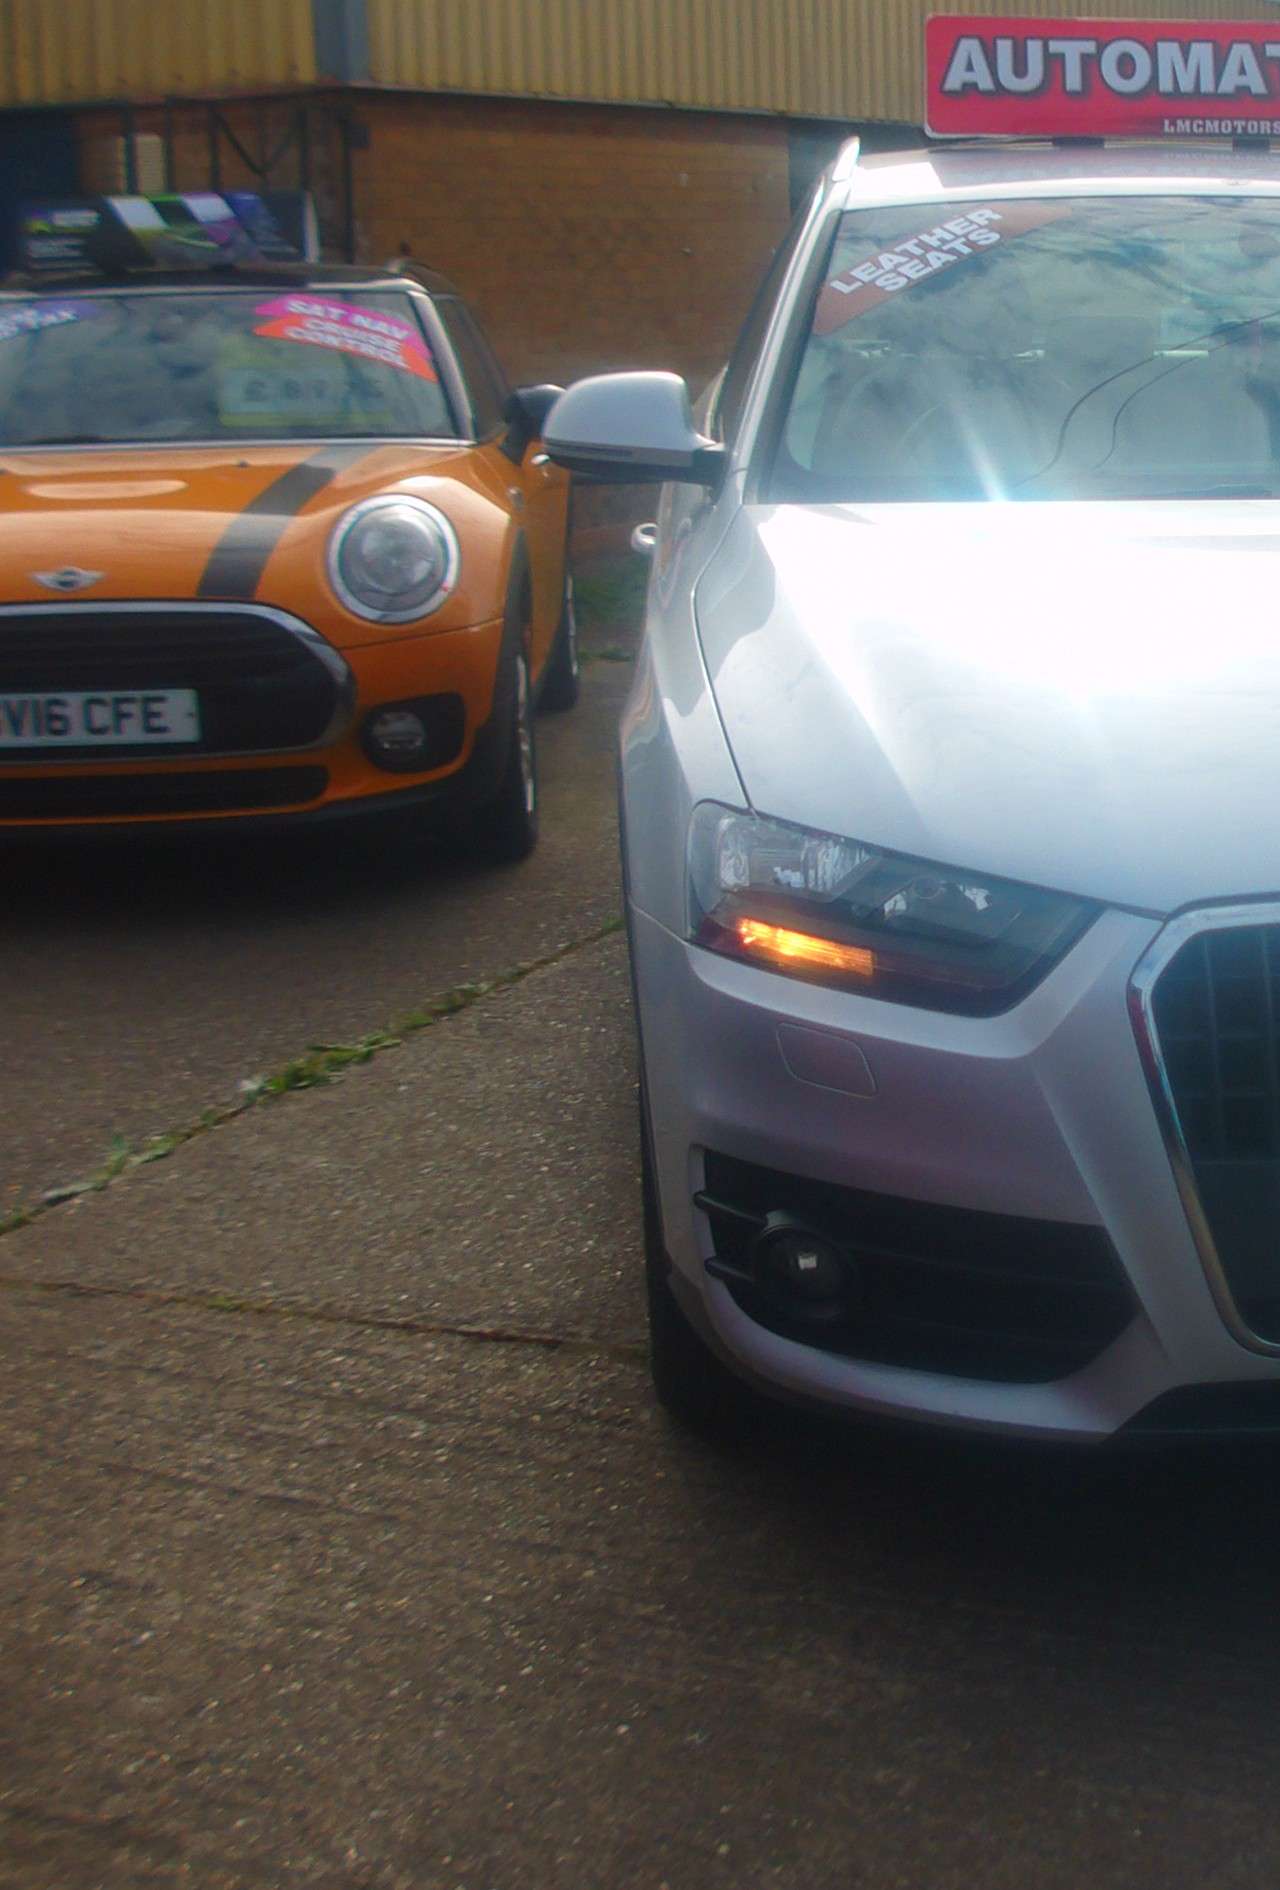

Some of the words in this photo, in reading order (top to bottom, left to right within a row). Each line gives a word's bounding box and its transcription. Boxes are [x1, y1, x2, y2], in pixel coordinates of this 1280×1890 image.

[830, 207, 1003, 296] LEATHER
[874, 228, 1001, 292] SEATS
[287, 300, 347, 320] SAT
[349, 312, 410, 340] NAV
[303, 319, 402, 352] CRUISE
[284, 326, 410, 368] CONTROL
[83, 696, 170, 735] CFE
